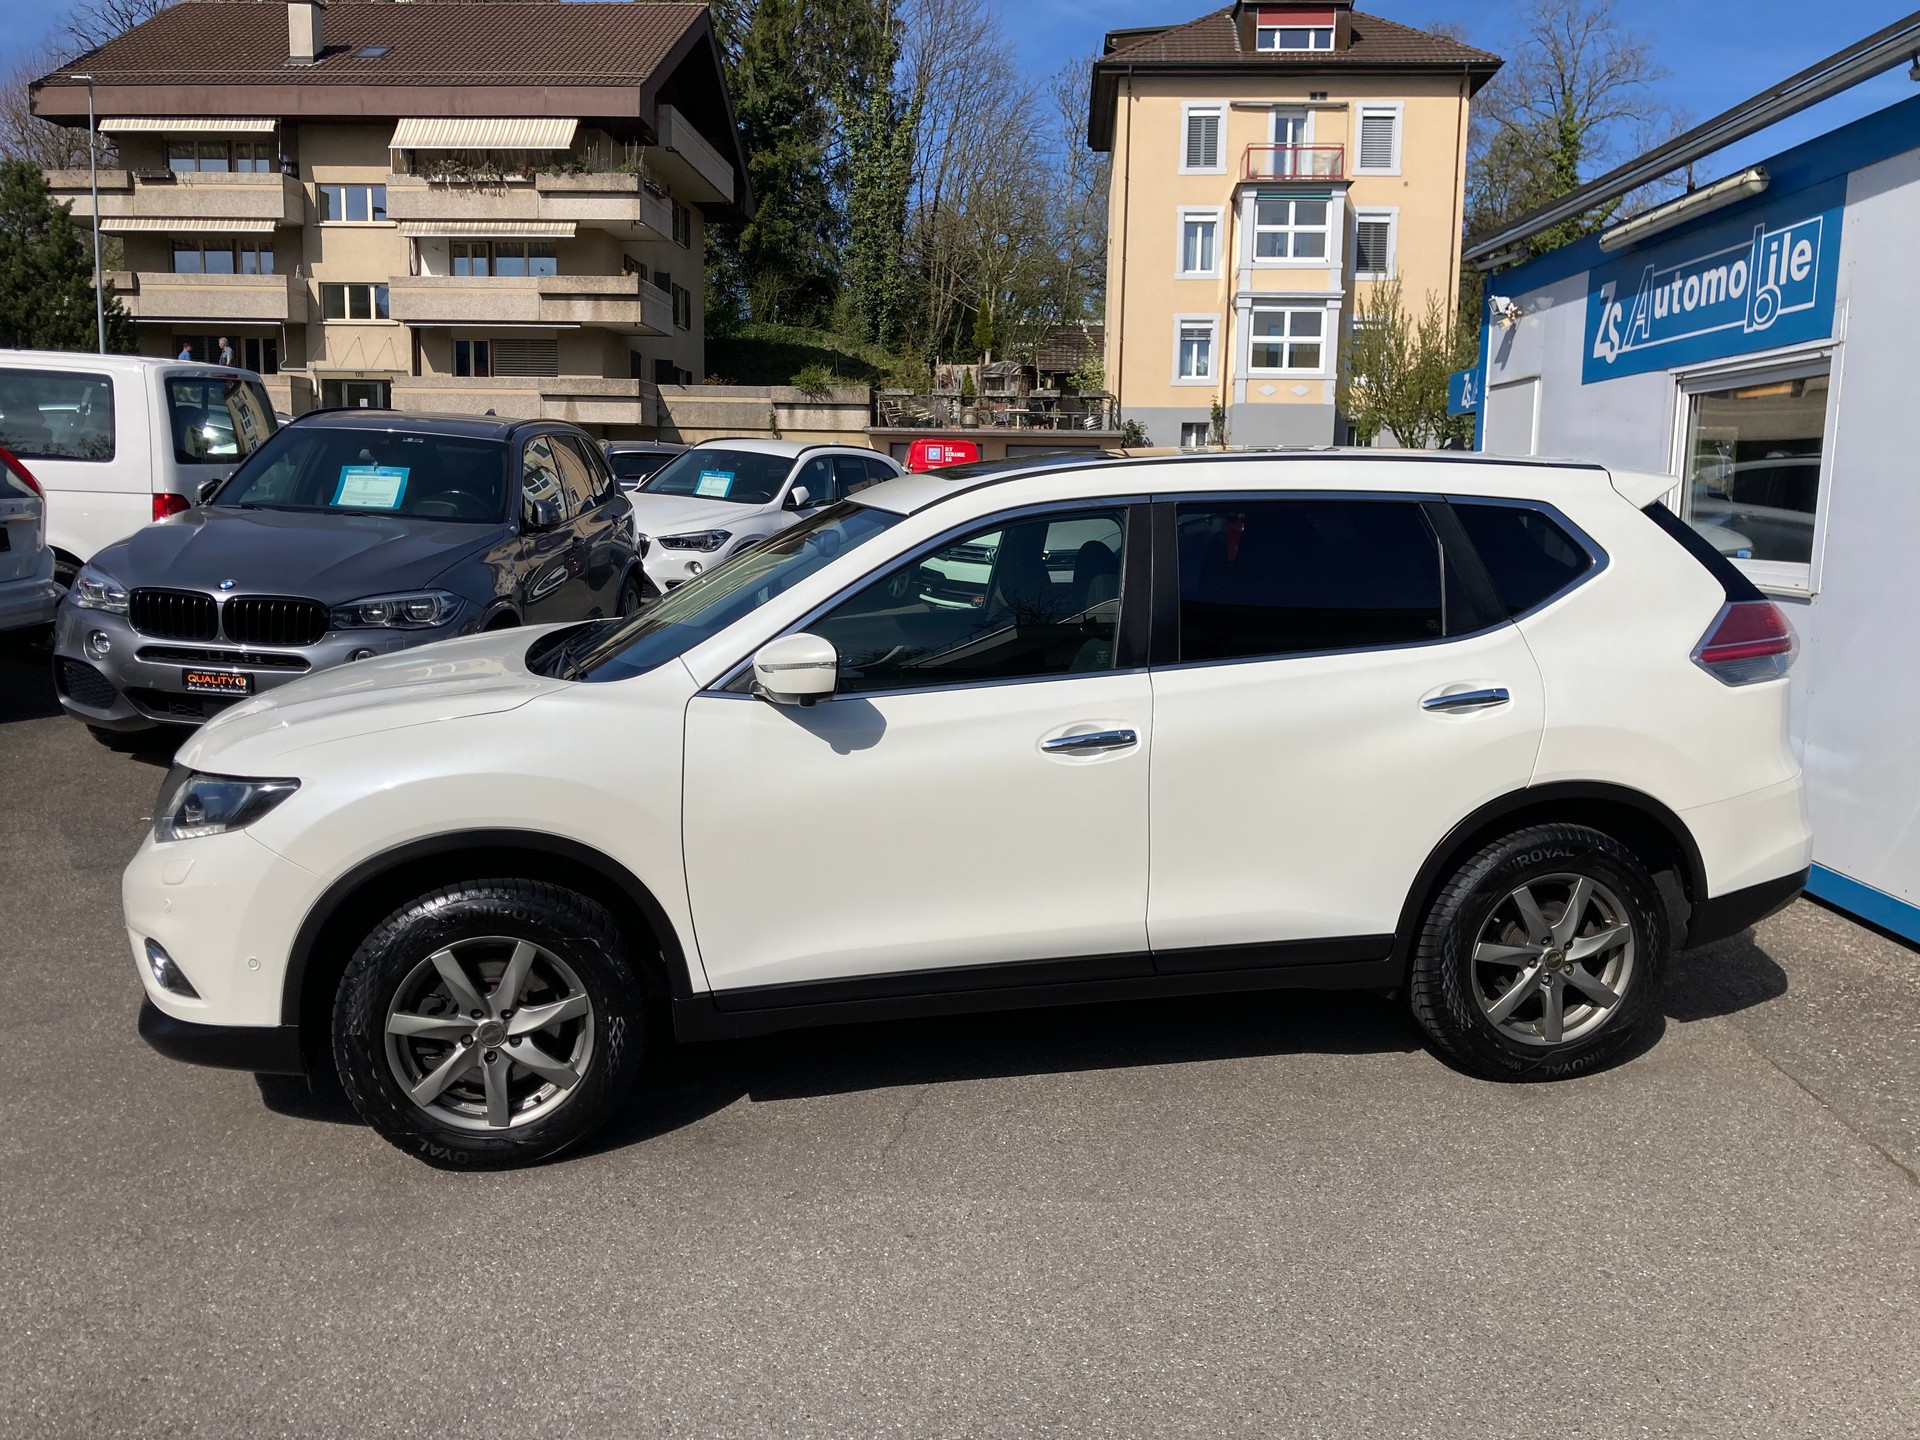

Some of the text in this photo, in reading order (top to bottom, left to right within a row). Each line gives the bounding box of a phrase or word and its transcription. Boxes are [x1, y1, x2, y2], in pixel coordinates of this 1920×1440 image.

[1593, 222, 1813, 364] Zs Automobile
[187, 674, 235, 685] QUALITY
